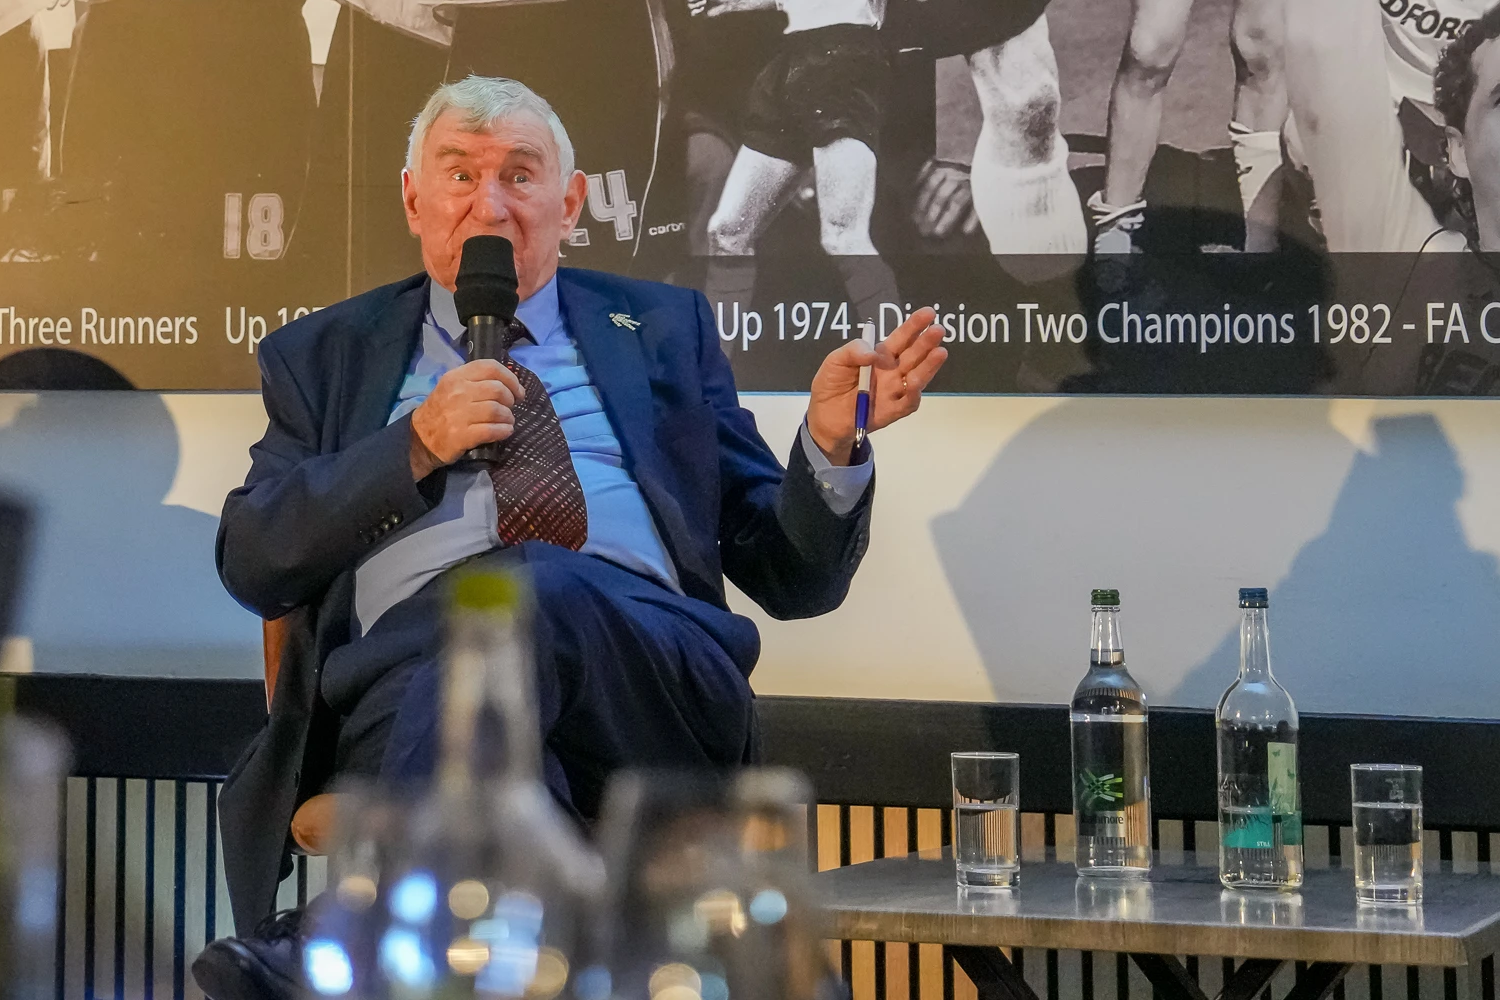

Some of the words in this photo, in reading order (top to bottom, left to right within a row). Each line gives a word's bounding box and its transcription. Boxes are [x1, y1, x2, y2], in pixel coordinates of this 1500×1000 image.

[223, 192, 285, 260] 18
[81, 306, 199, 345] Runners
[225, 306, 267, 354] Up
[717, 301, 763, 351] Up
[773, 301, 849, 341] 1974
[879, 302, 1010, 344] Diision
[1016, 302, 1088, 344] Two
[1097, 301, 1295, 354] Champions
[1307, 303, 1392, 345] 1982
[1426, 302, 1470, 344] FA
